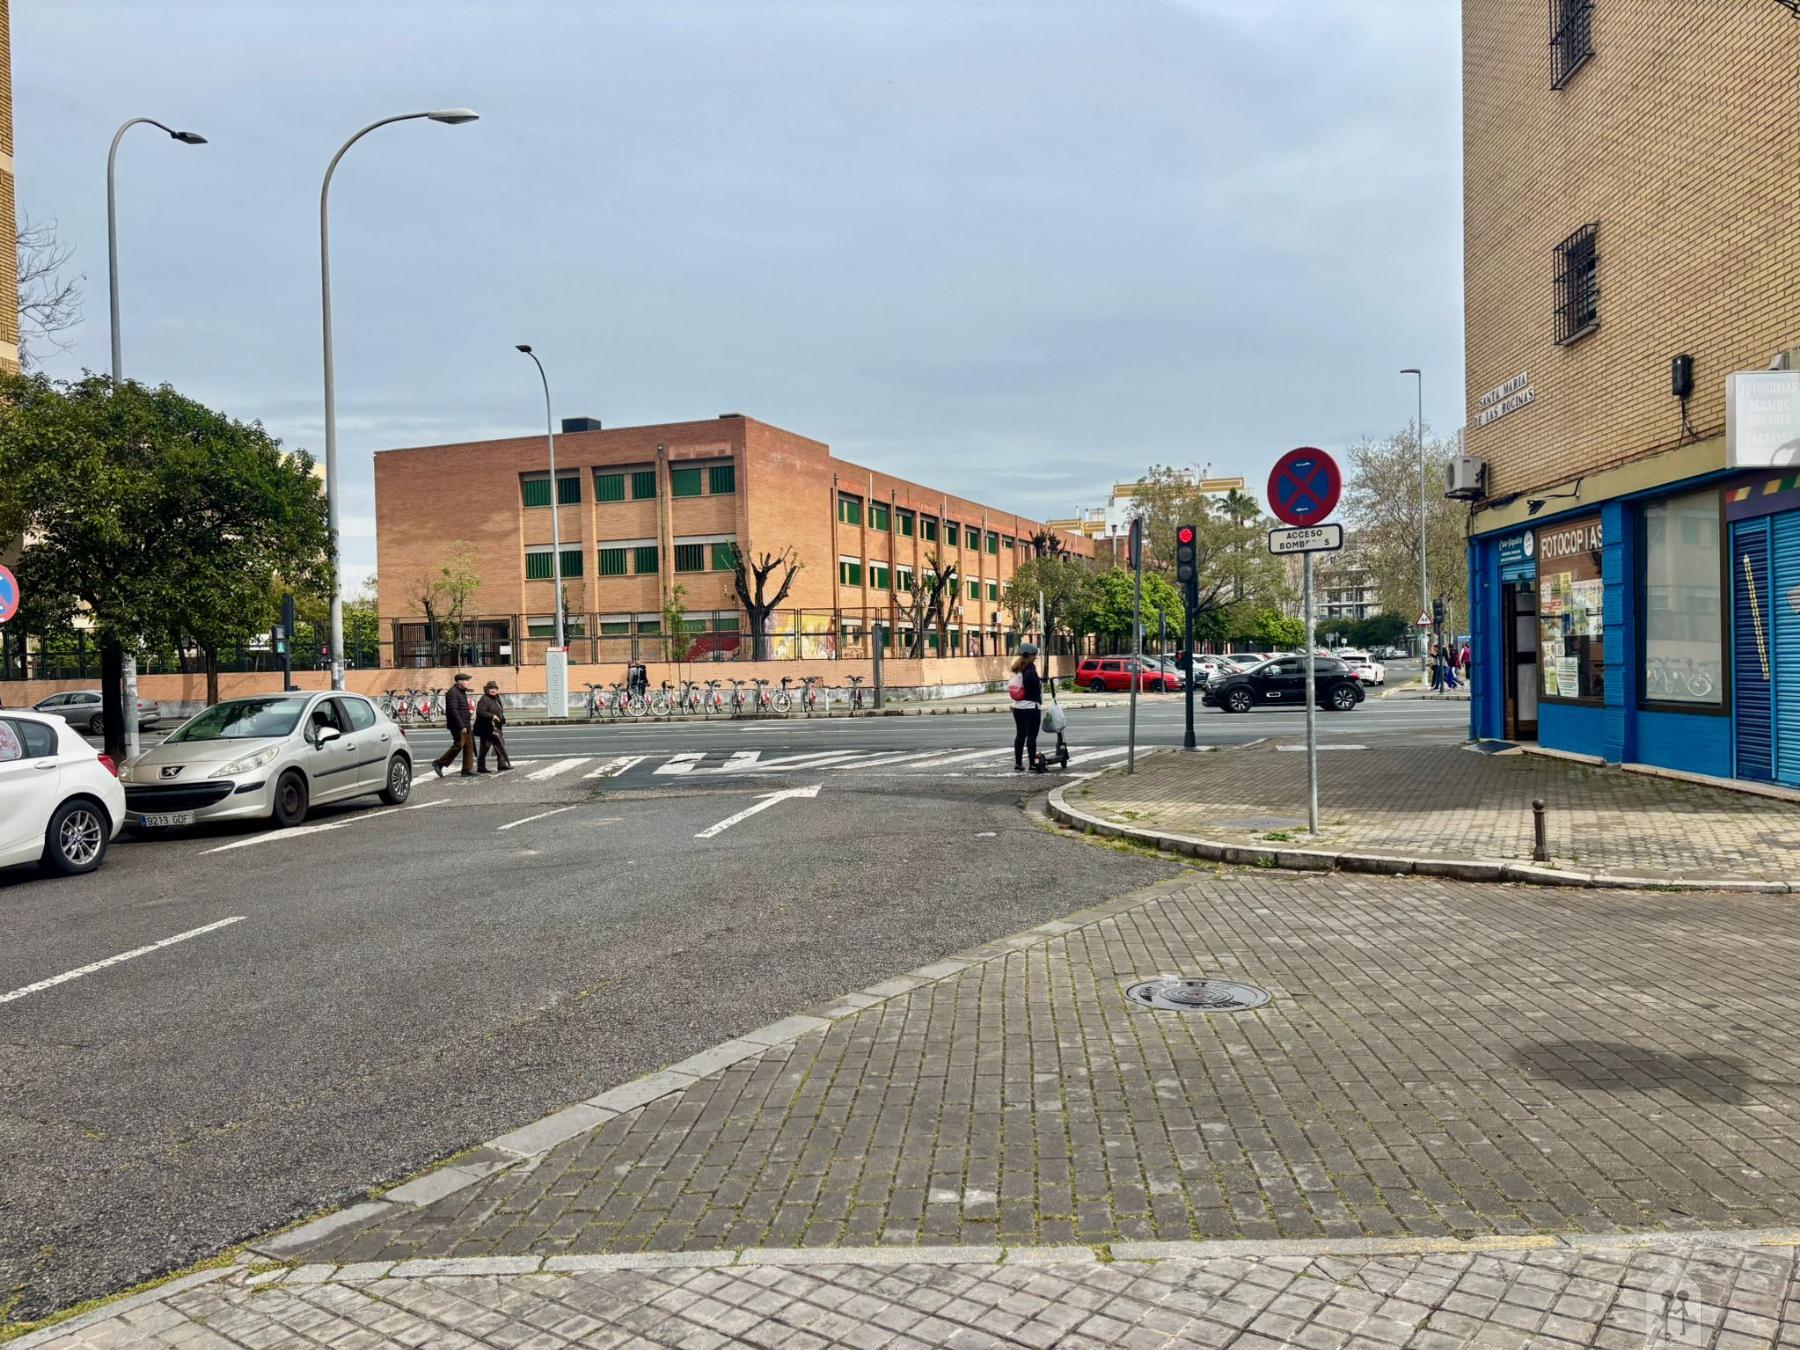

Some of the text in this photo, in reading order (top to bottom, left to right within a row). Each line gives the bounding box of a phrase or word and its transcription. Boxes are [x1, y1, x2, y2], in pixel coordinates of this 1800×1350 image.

[1478, 389, 1500, 407] SANTA
[1485, 406, 1498, 422] LAS
[1501, 388, 1534, 414] ROCINAS
[1286, 529, 1323, 539] ACCESO
[1541, 524, 1603, 559] FOTOCOPIAS
[1279, 538, 1330, 550] BOMBS
[147, 815, 169, 825] 9213
